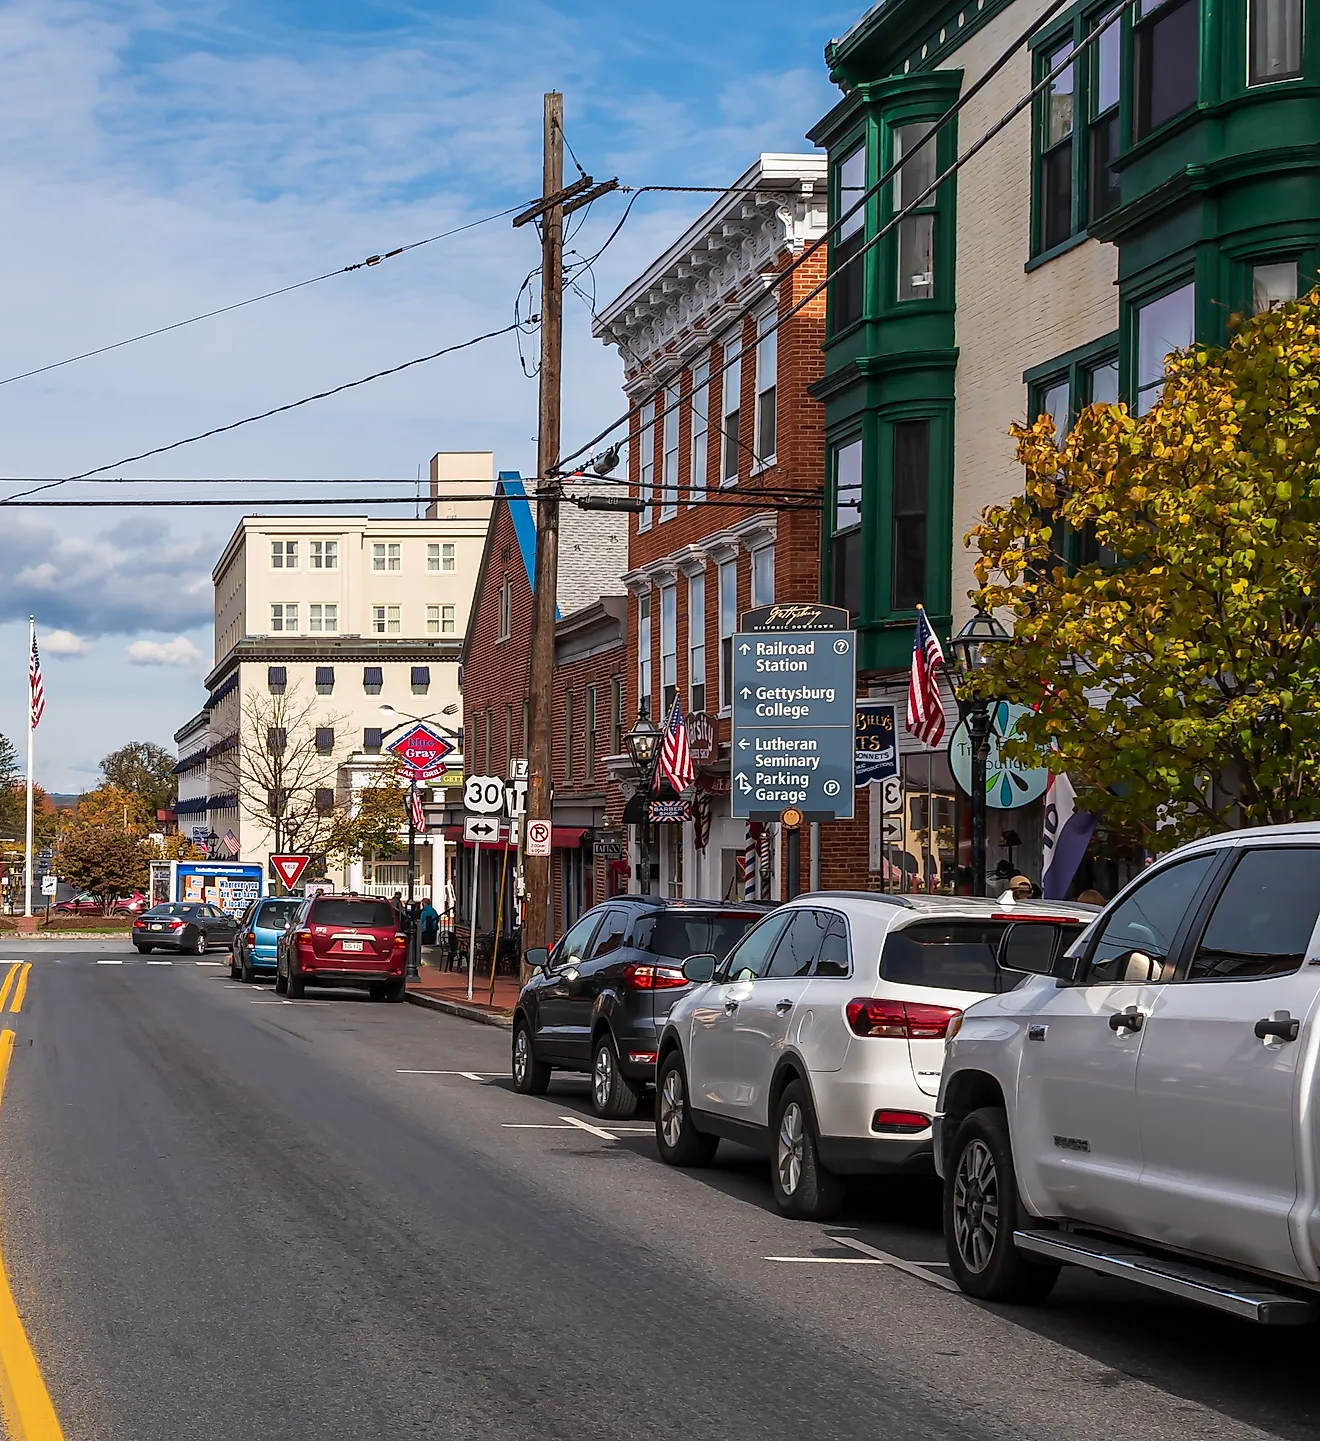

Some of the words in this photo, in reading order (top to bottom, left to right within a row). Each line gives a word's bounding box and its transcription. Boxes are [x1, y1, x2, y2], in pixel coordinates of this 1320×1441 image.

[765, 606, 822, 625] Gettysburg
[756, 641, 815, 655] Railroad
[756, 658, 808, 672] Station
[755, 686, 836, 702] Gettysburg
[755, 703, 809, 719] College
[408, 737, 435, 747] Blue
[755, 737, 817, 751] Lutheran
[855, 735, 880, 751] TS
[405, 749, 437, 760] Gray
[755, 754, 820, 770] Seminary
[422, 767, 445, 778] GRILL
[755, 772, 809, 788] Parking
[468, 782, 499, 804] 30
[755, 788, 807, 804] Garage
[220, 881, 247, 889] Wherever
